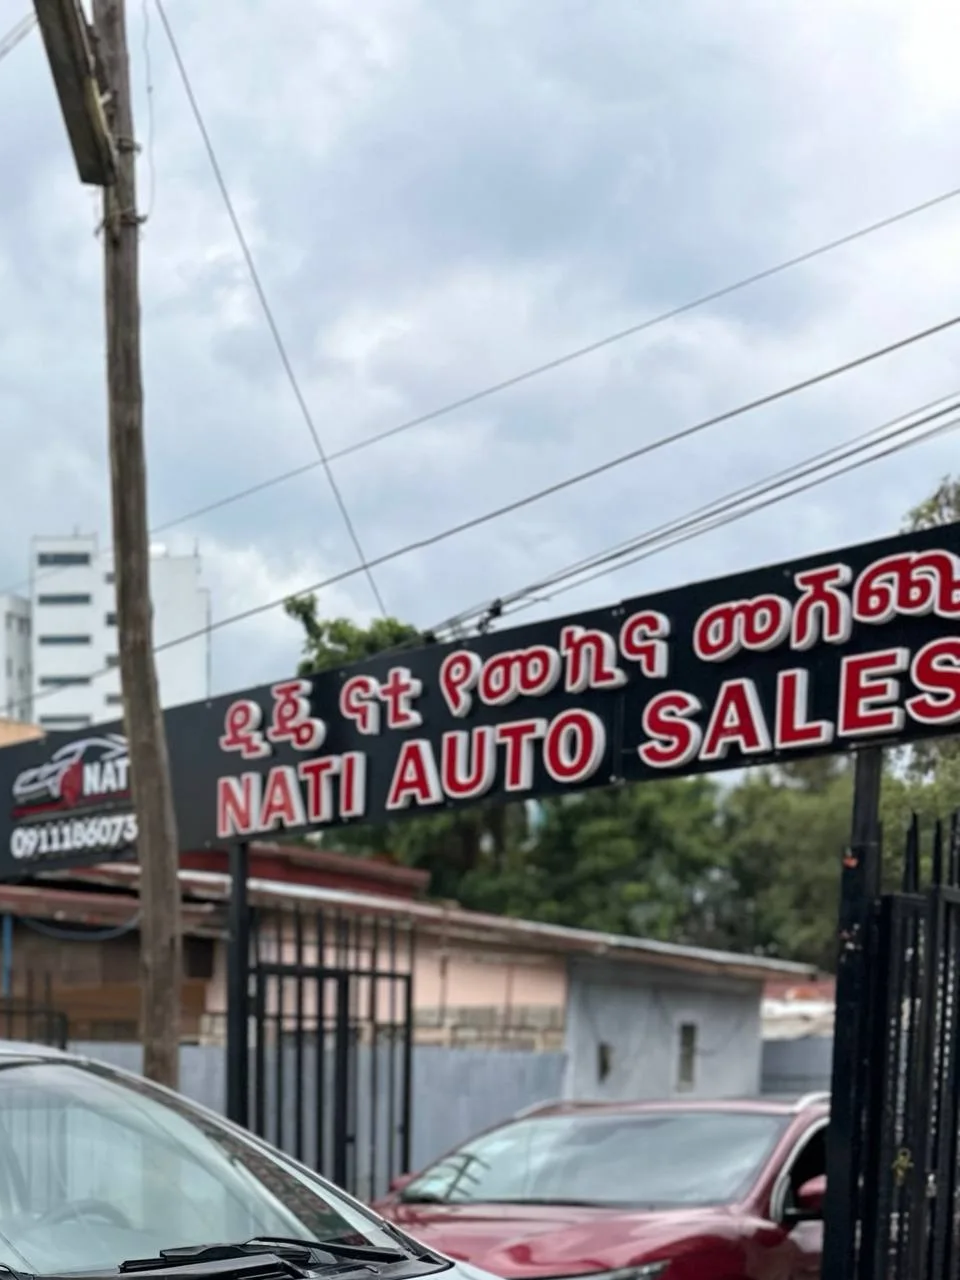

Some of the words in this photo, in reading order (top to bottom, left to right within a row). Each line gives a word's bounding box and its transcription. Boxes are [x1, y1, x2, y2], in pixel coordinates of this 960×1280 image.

[440, 610, 671, 718] የመኪና
[83, 758, 131, 796] NAT
[217, 752, 367, 838] NATI
[386, 708, 606, 810] AUTO
[638, 637, 960, 768] SALES
